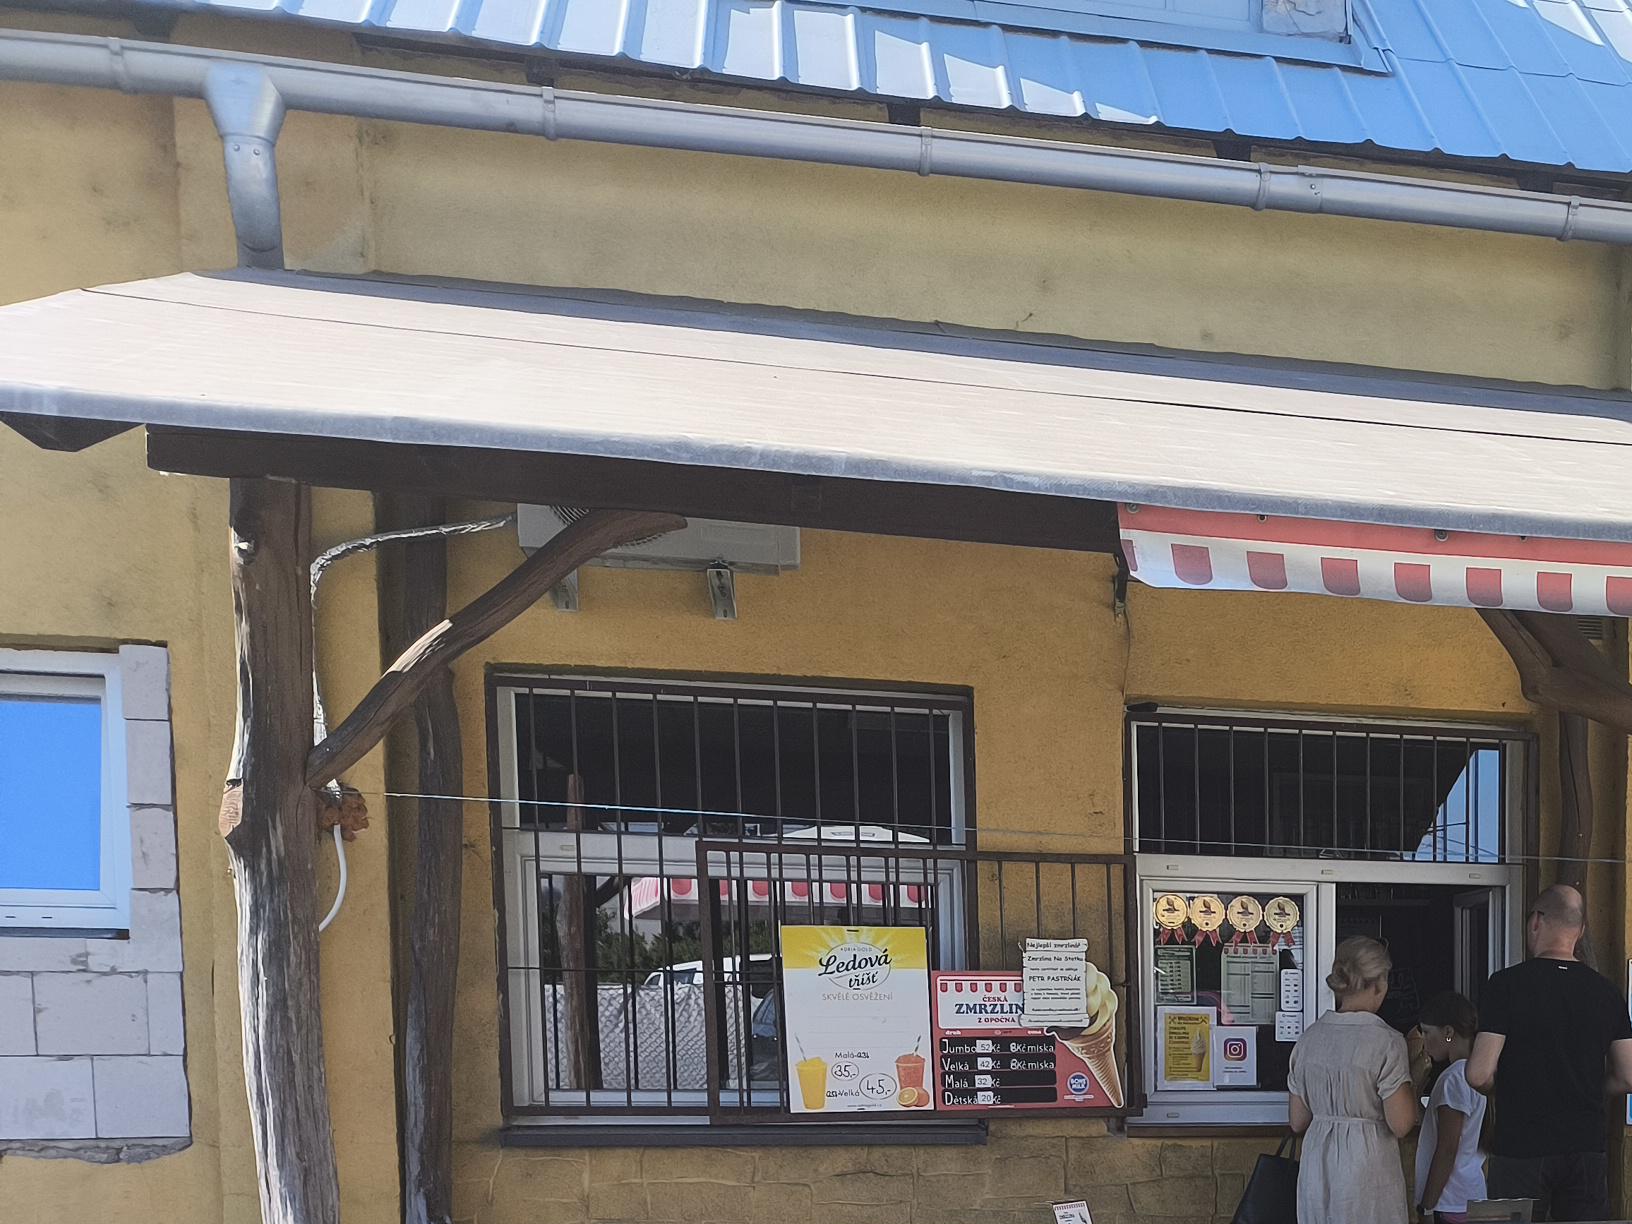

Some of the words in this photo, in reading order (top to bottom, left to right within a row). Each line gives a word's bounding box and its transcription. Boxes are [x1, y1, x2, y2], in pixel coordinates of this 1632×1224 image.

[818, 948, 892, 977] Ledová
[848, 970, 879, 988] tříšť
[982, 995, 1008, 1003] ČESKÁ
[955, 1003, 1024, 1015] ZMRZLIN
[942, 1039, 976, 1053] Jumbo
[942, 1057, 970, 1071] Velká
[980, 1060, 990, 1068] 42
[945, 1074, 968, 1088] Malá
[944, 1091, 978, 1105] Dětská
